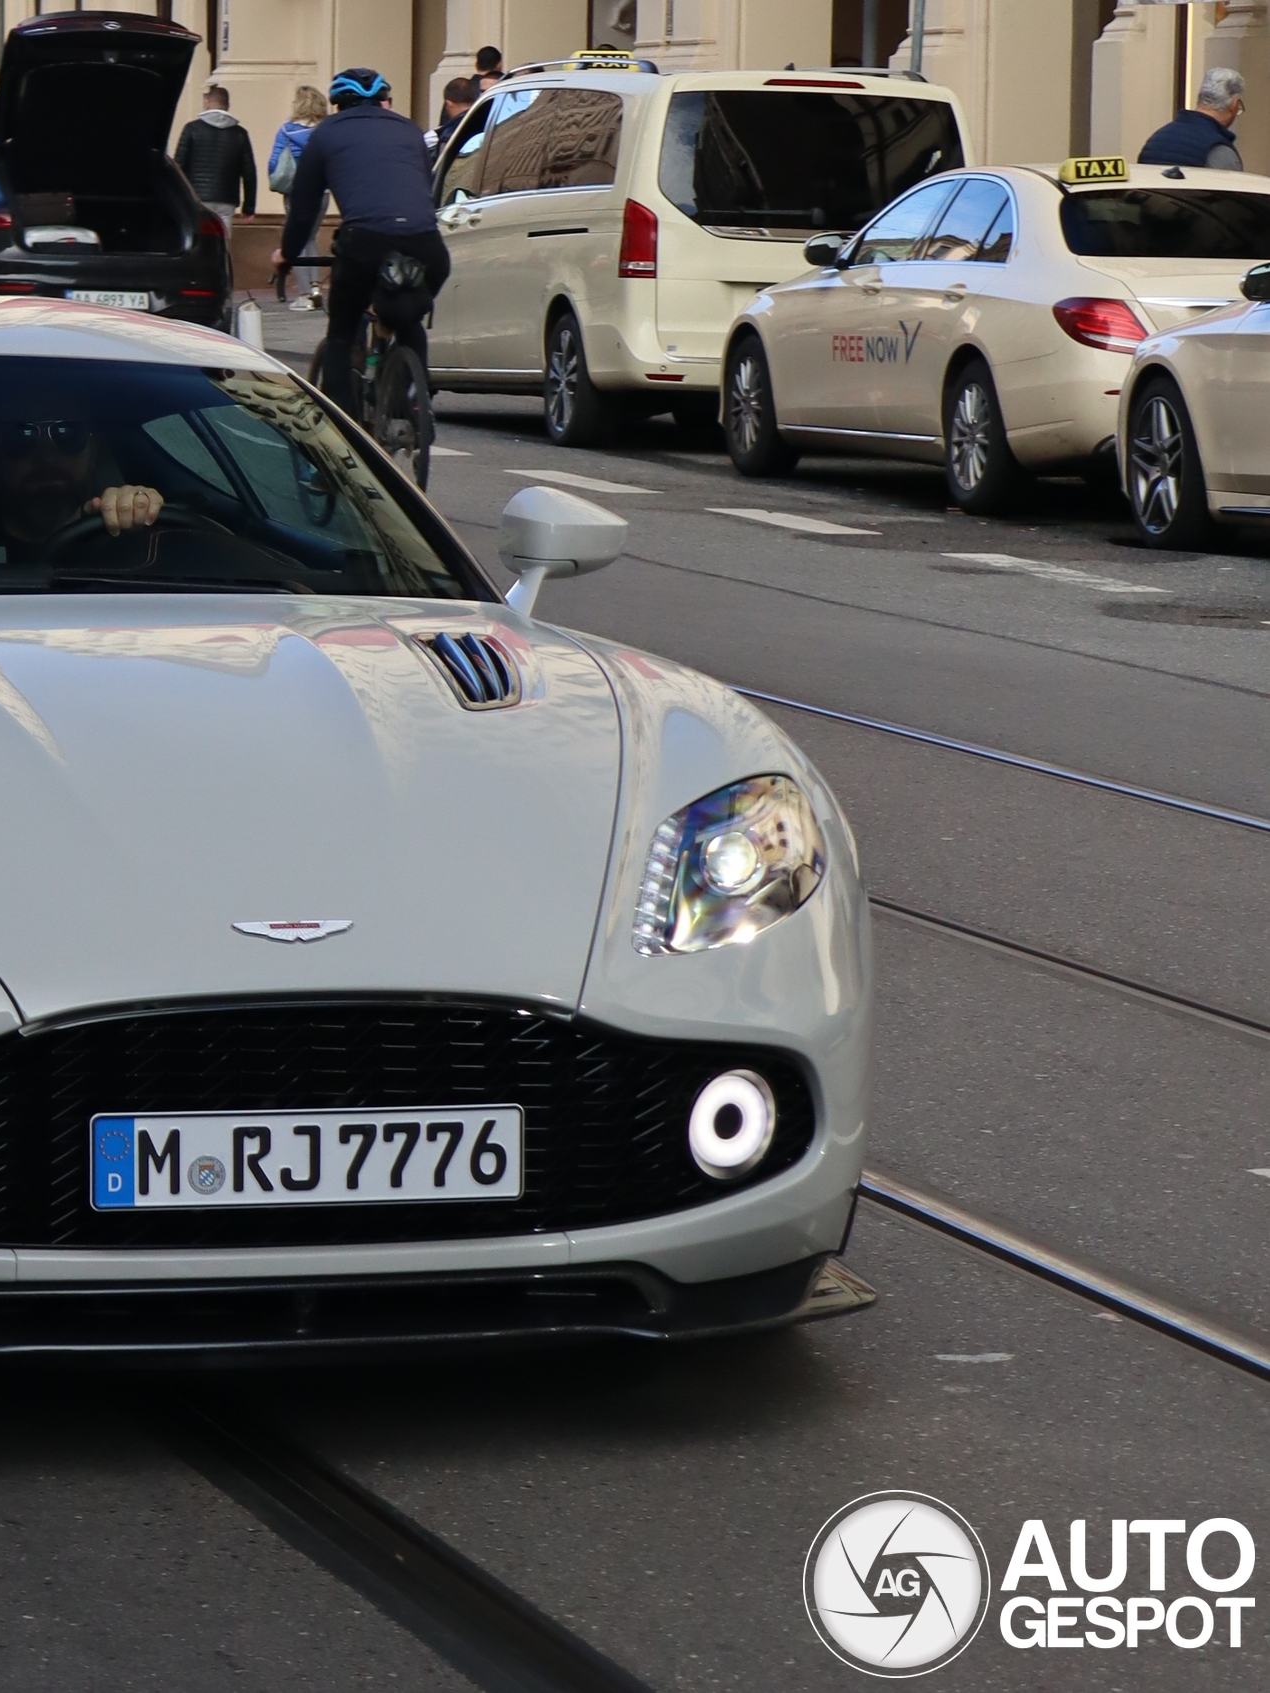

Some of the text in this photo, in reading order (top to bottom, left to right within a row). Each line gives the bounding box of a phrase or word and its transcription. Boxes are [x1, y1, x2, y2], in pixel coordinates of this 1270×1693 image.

[1076, 160, 1124, 177] TAXI
[96, 293, 126, 307] 6893
[137, 1128, 181, 1196] M
[338, 1119, 508, 1190] 7776
[108, 1172, 123, 1192] D
